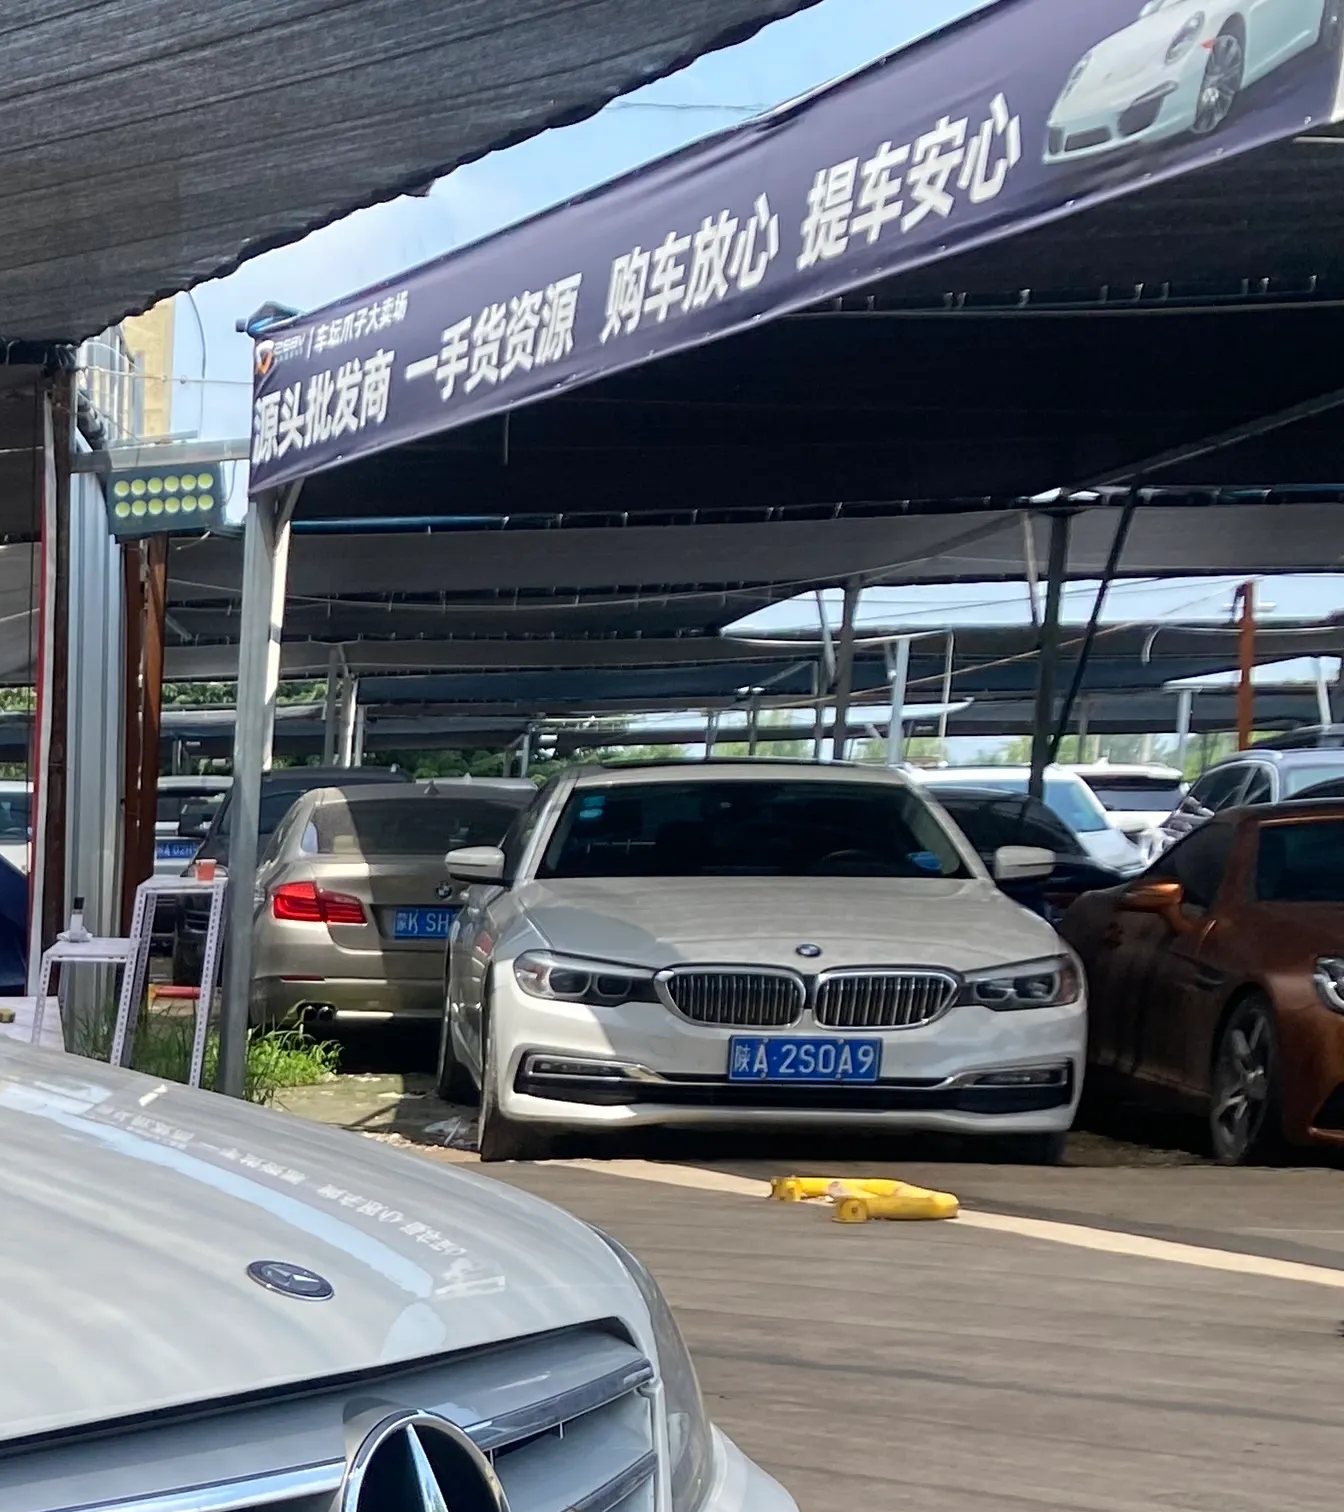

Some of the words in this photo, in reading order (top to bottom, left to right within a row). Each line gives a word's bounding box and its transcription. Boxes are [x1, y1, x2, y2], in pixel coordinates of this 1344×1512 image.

[253, 349, 395, 465] 源头批发商
[405, 272, 582, 402] 一手货资源
[599, 192, 779, 344] 购车放心
[797, 92, 1021, 271] 提车安心
[315, 291, 409, 353] 车坛爪子大卖场
